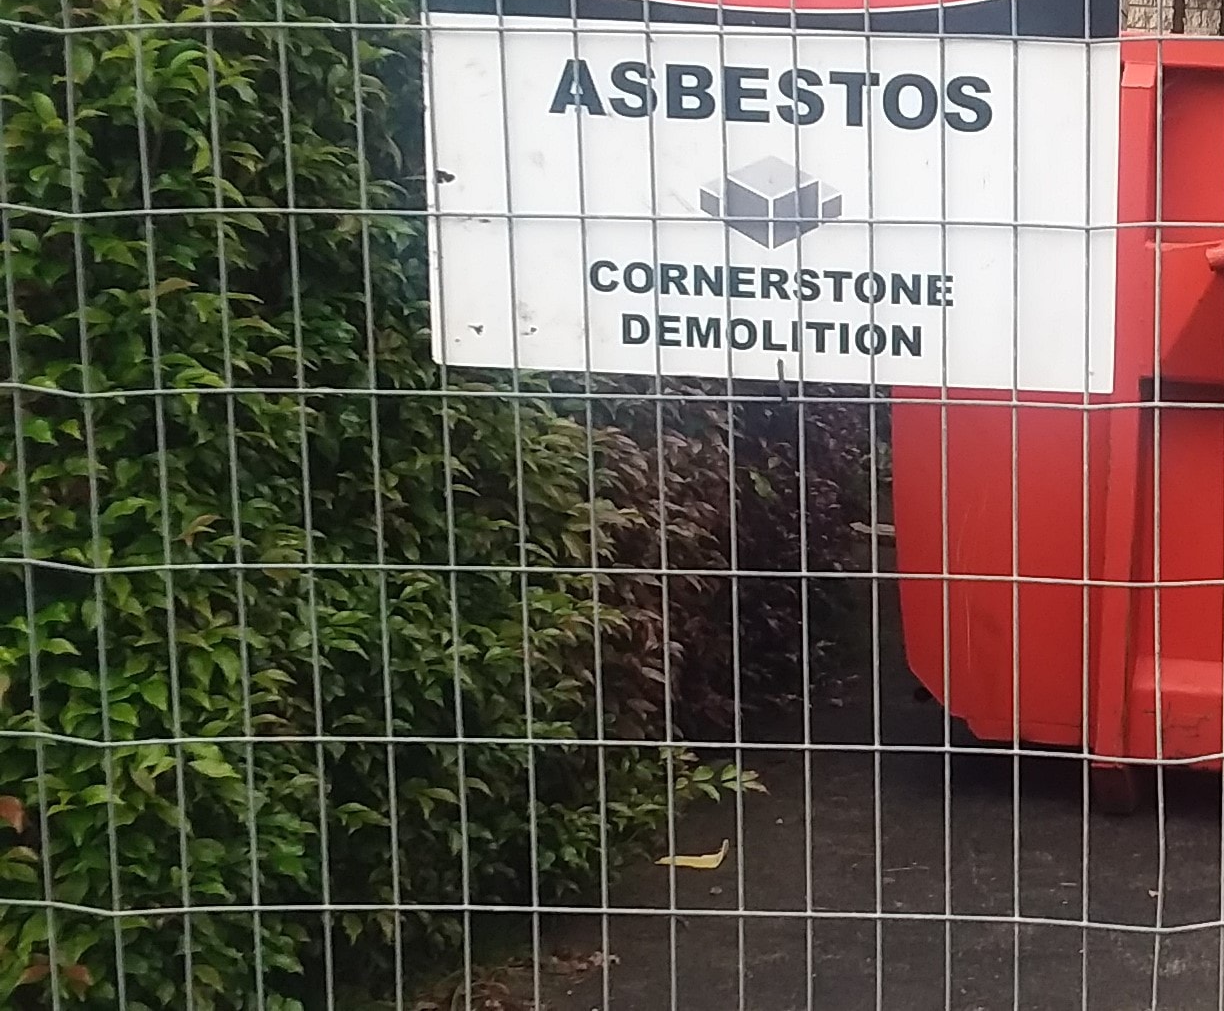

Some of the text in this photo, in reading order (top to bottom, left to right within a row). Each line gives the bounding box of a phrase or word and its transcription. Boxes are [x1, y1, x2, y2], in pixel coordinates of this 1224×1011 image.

[549, 59, 993, 132] ASBESTOS
[590, 259, 954, 307] CORNERSTONE
[621, 313, 922, 357] DEMOLITION
